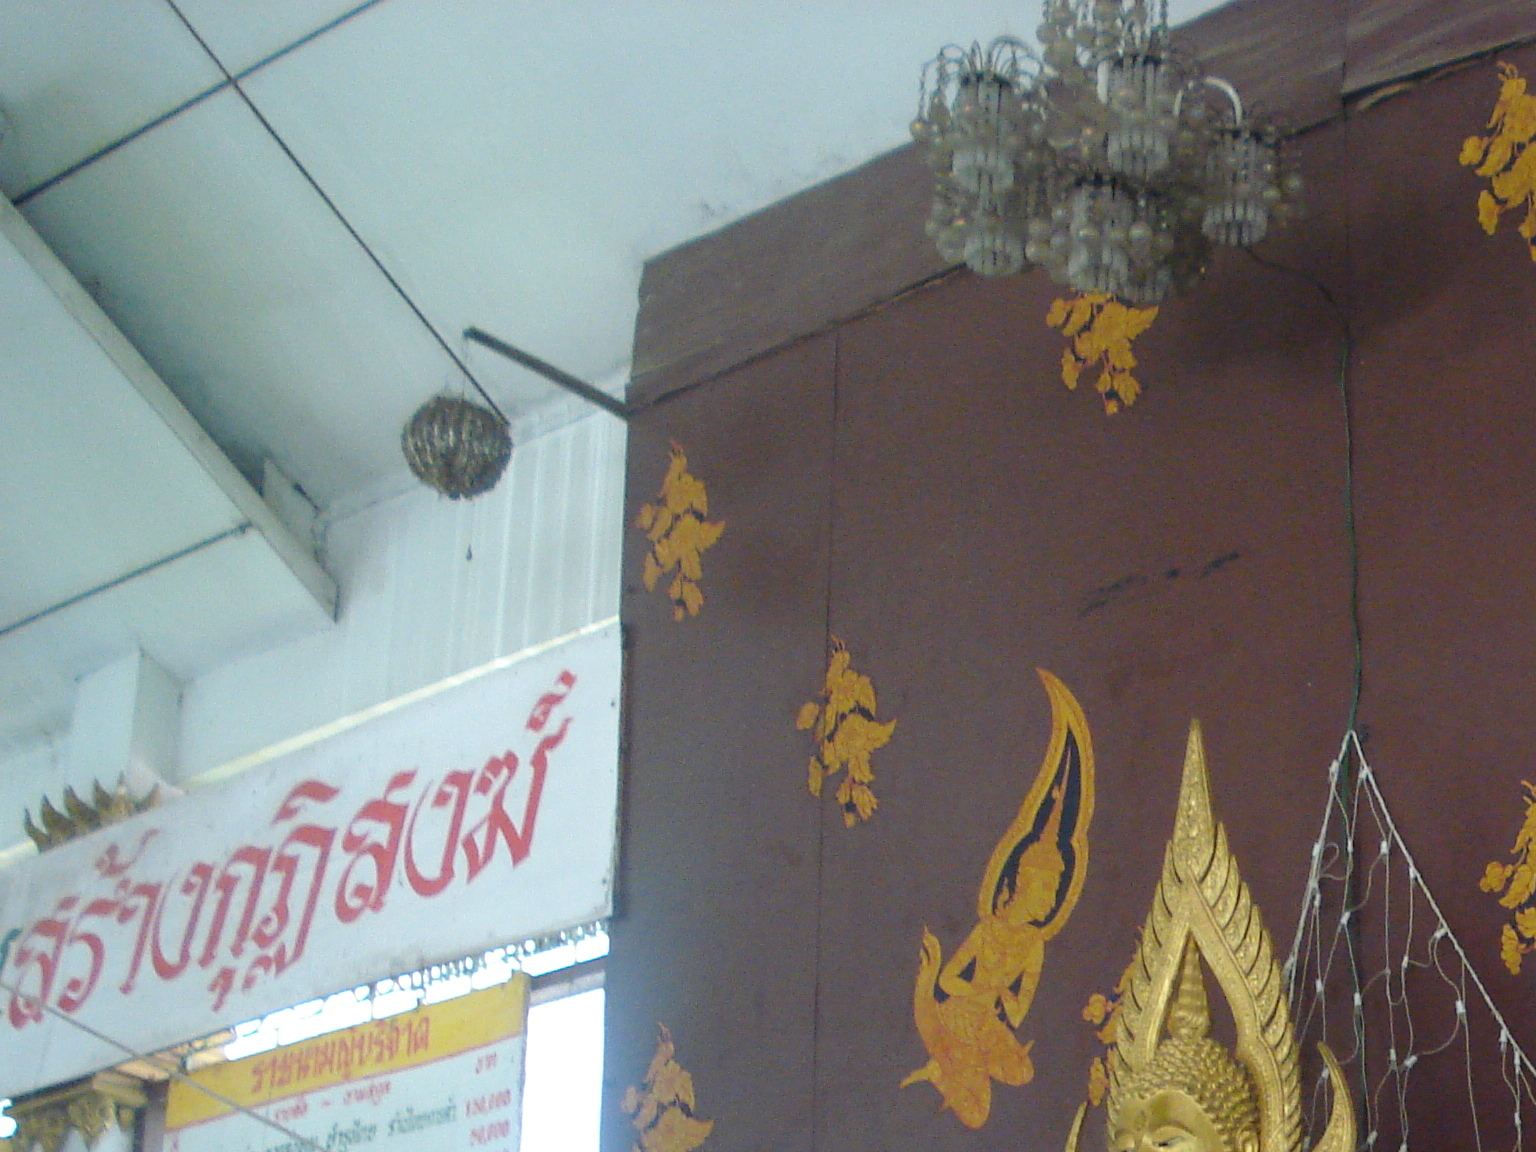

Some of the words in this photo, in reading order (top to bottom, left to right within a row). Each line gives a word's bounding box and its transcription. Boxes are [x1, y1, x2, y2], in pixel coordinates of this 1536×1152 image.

[8, 670, 578, 1029] สร้างกุฏิสงฆ์
